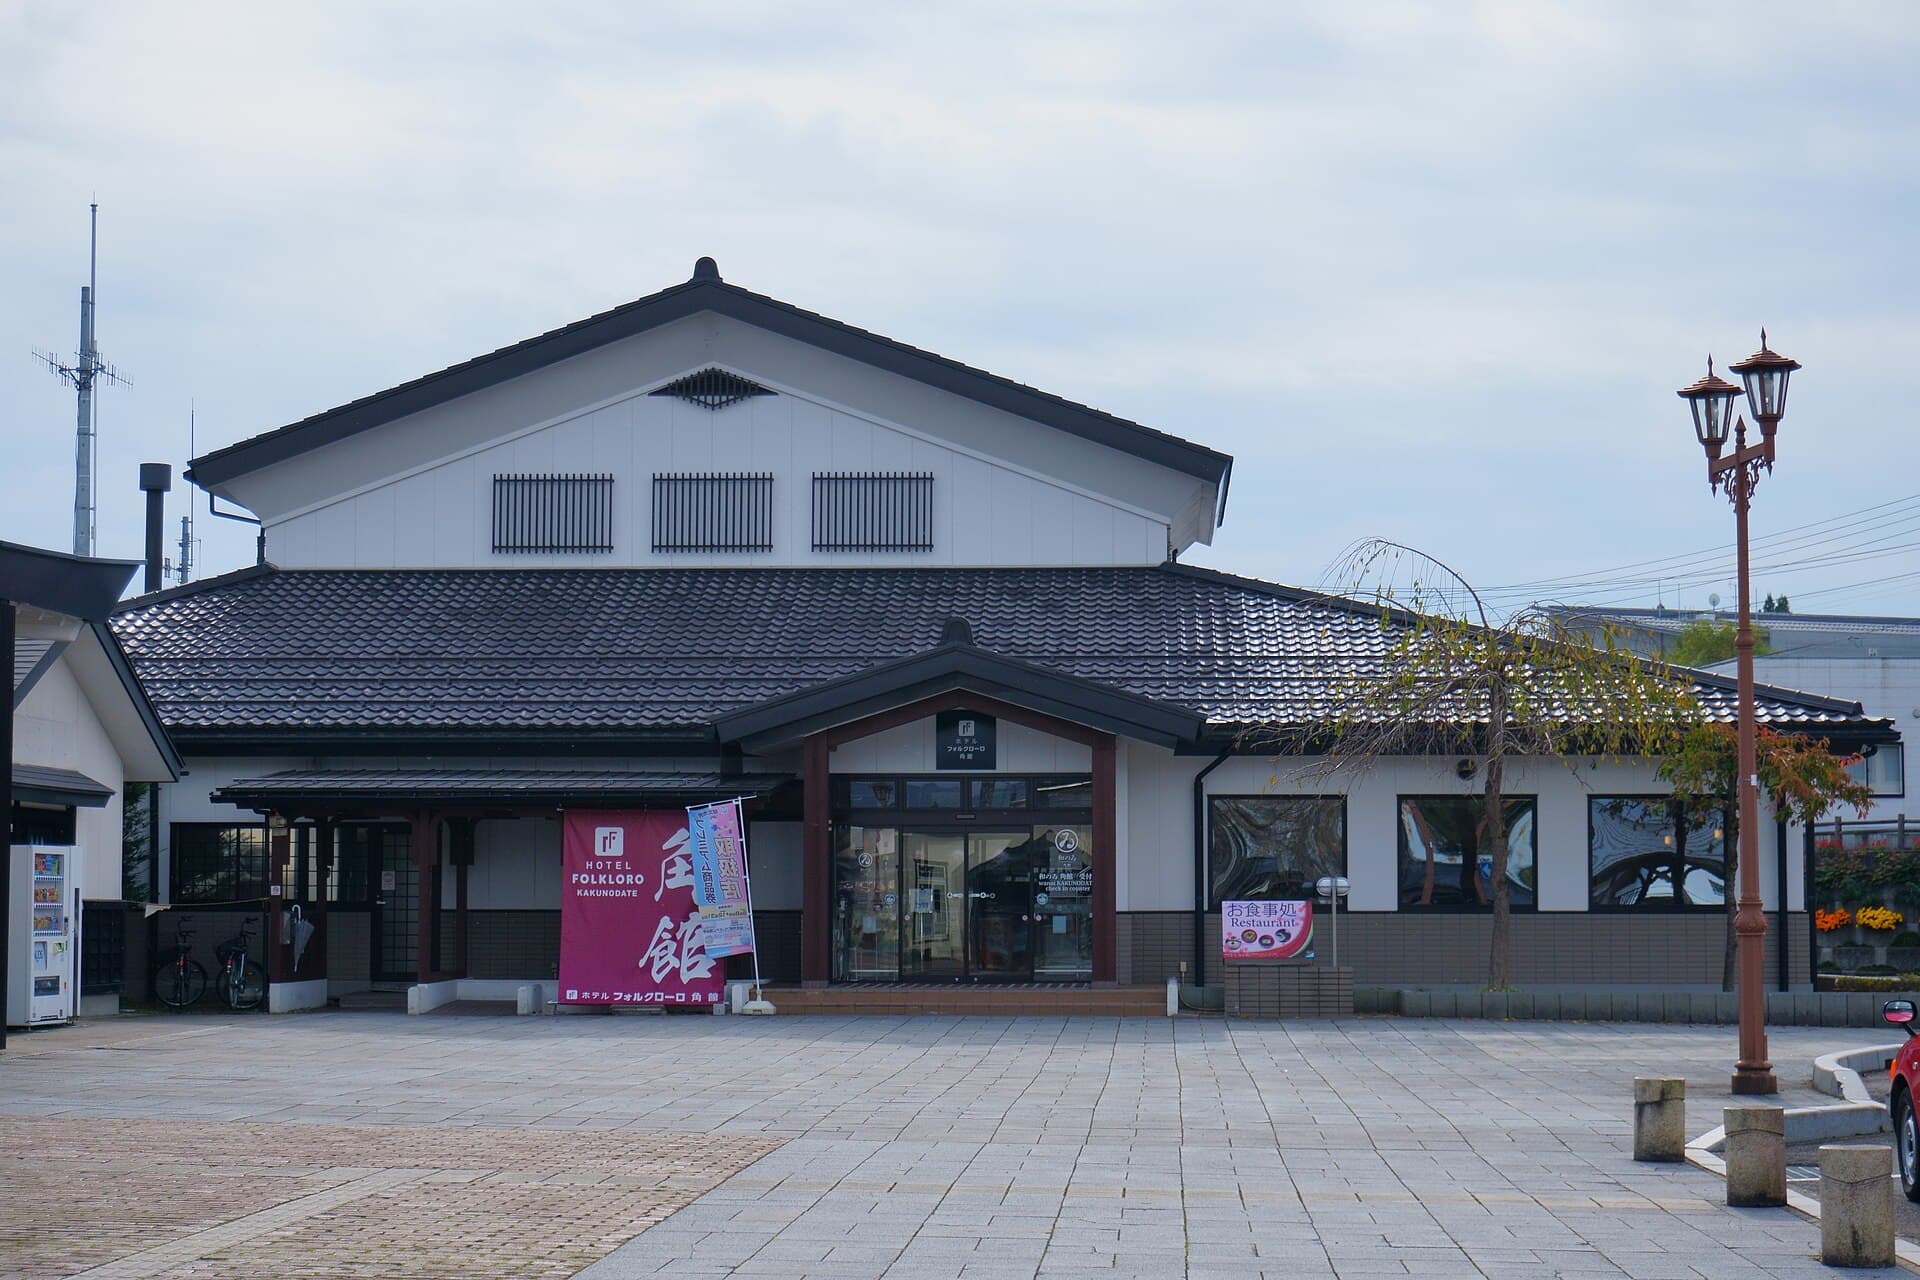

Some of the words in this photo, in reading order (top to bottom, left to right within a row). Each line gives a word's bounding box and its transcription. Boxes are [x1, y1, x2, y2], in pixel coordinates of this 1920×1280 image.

[586, 861, 632, 870] HOTEL
[572, 873, 644, 885] FOLKLORO
[576, 889, 638, 898] KAKUNODATE
[1227, 902, 1297, 918] お食事処
[1231, 917, 1296, 928] Restaurant
[581, 992, 610, 1000] ホテル
[613, 992, 686, 1002] フォルクローロ
